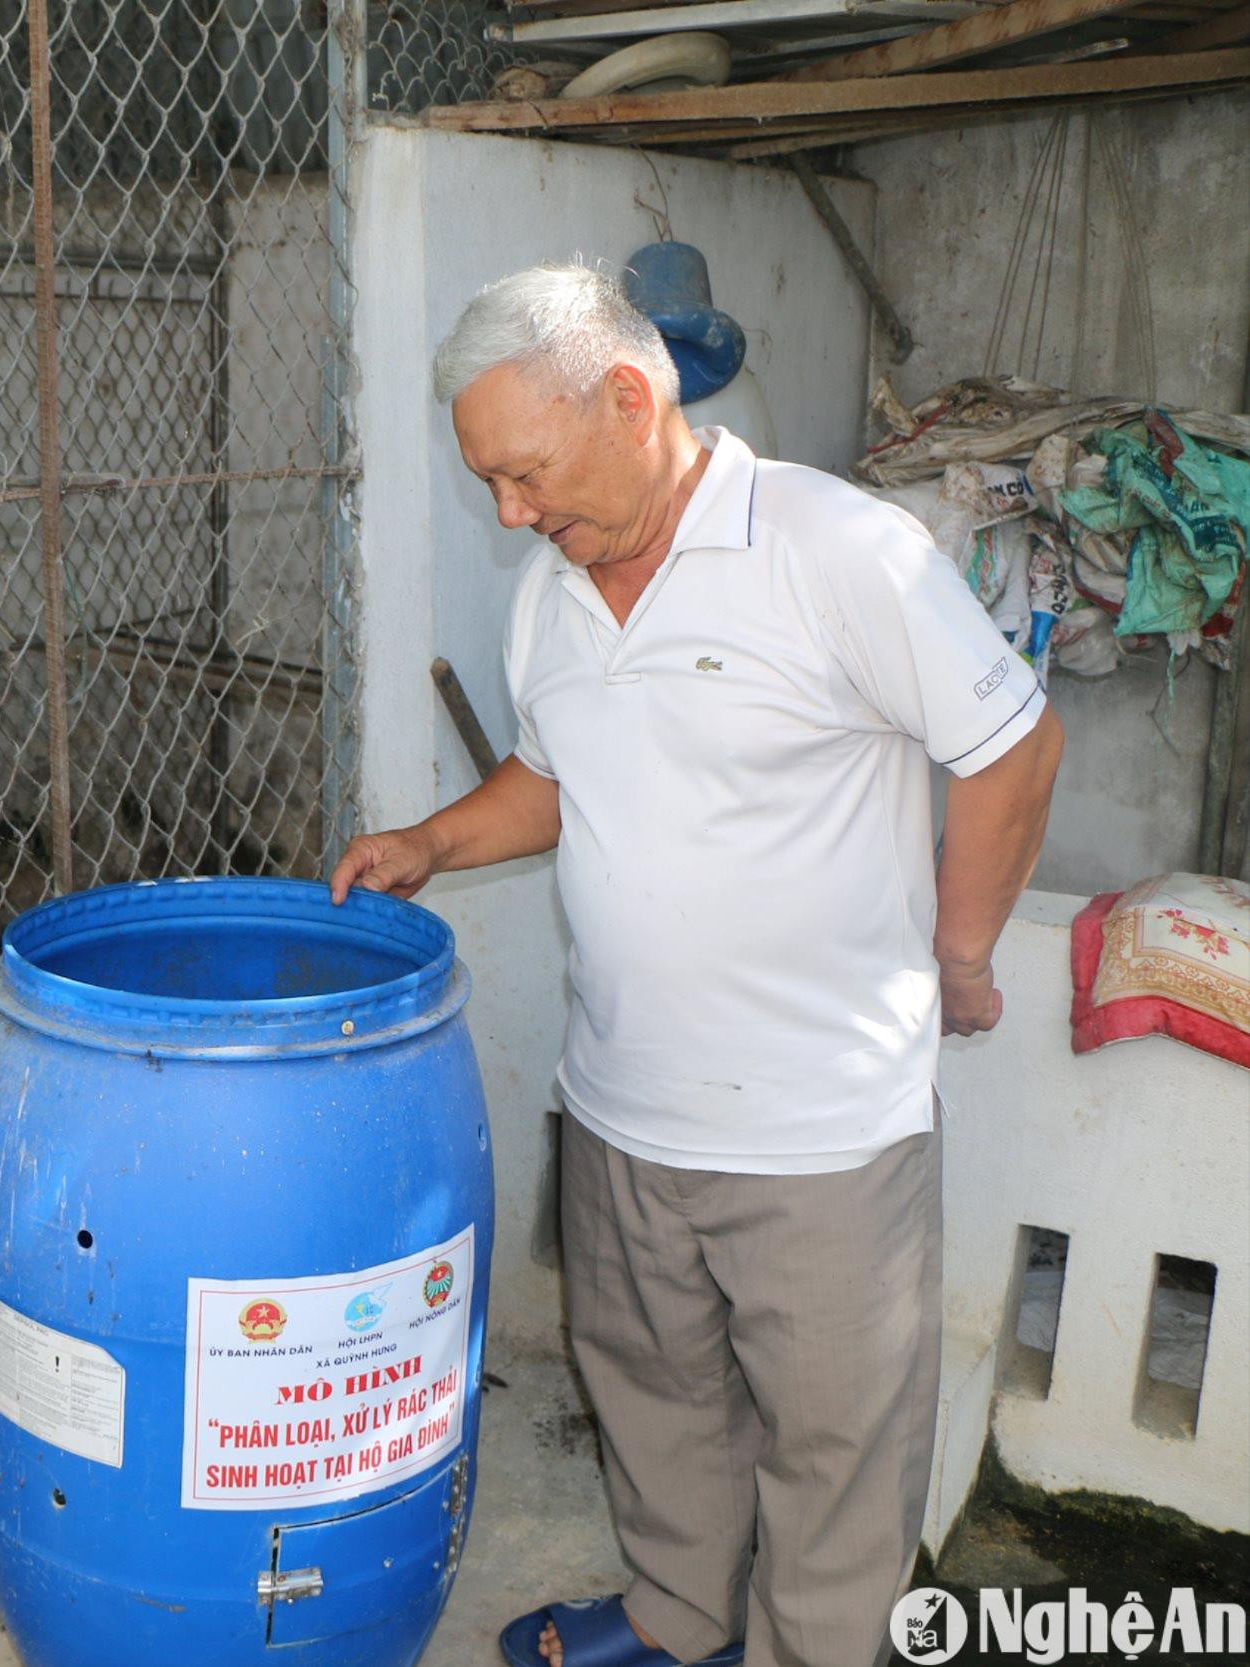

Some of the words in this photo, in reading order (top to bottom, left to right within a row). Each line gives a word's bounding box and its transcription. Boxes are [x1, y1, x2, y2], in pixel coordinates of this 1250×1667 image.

[227, 1349, 250, 1357] BAN
[275, 1377, 333, 1405] MÔ
[344, 1355, 422, 1396] HÌNH
[285, 1418, 336, 1448] LOẠI,
[342, 1402, 370, 1437] XỬ
[373, 1398, 392, 1430] LÝ
[397, 1388, 427, 1421] RÁC
[431, 1365, 457, 1405] THẢI
[206, 1464, 258, 1488] SINH
[264, 1460, 318, 1489] HOẠT
[324, 1453, 353, 1482] TẠI
[358, 1441, 382, 1472] HỘ
[387, 1434, 413, 1463] GIA
